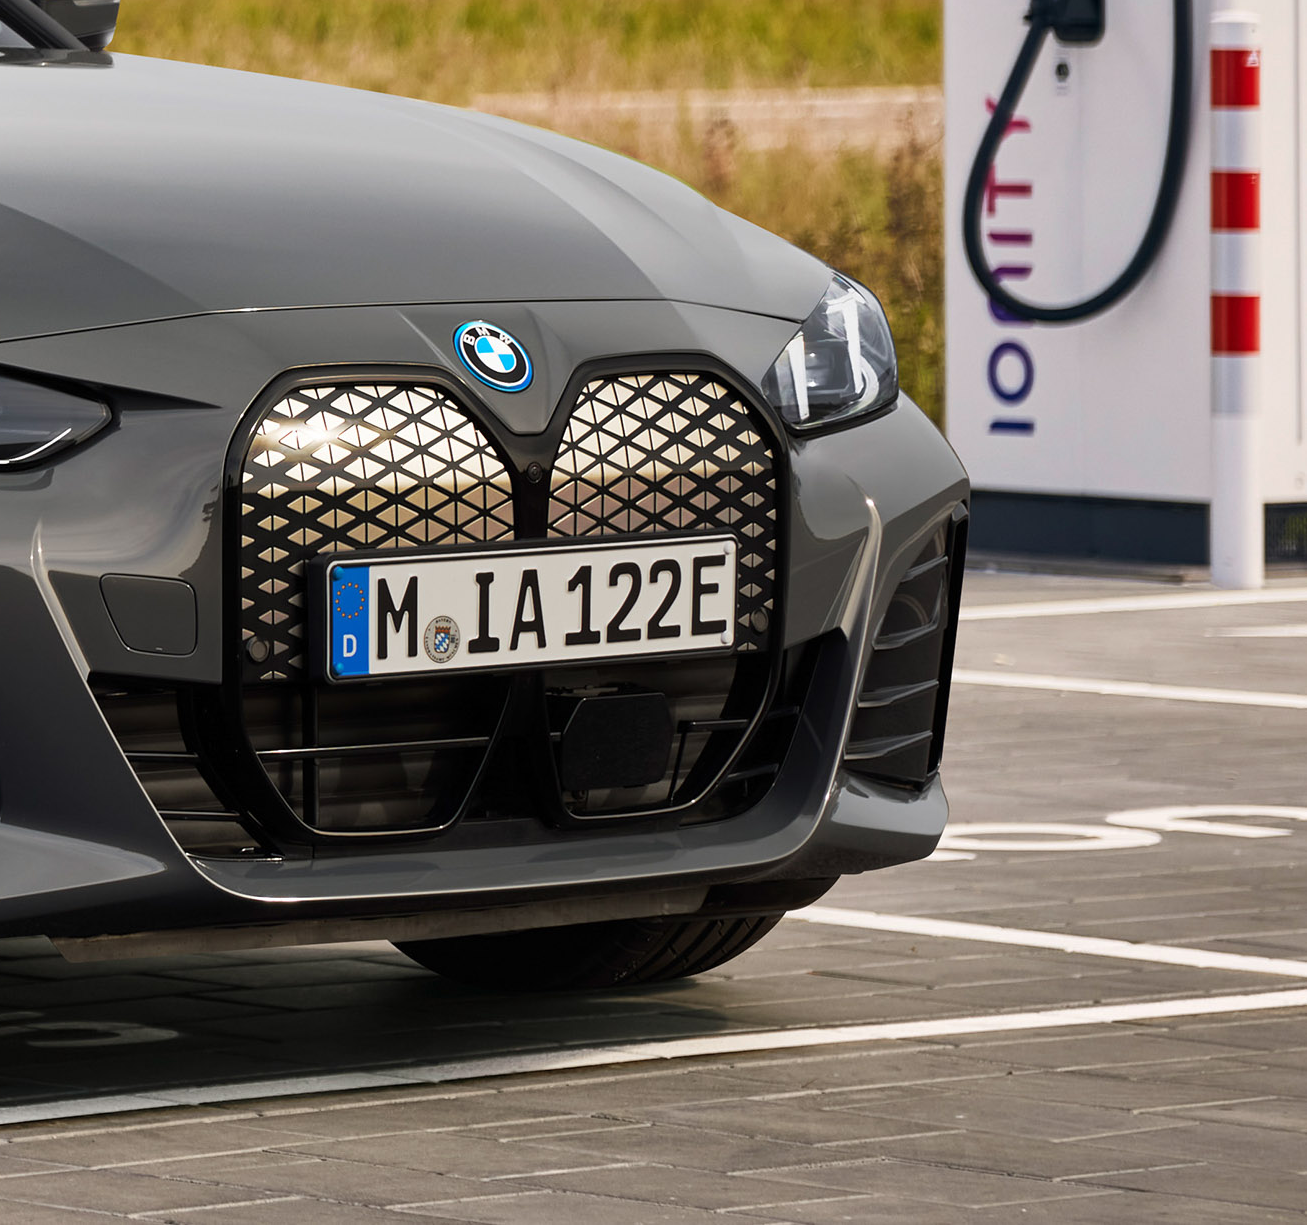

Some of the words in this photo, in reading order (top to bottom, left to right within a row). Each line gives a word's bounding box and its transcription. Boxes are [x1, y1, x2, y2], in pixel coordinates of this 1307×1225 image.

[463, 326, 514, 346] BMW
[377, 575, 419, 660] M
[468, 569, 547, 654] IA
[565, 553, 728, 646] 122E
[342, 634, 358, 658] D
